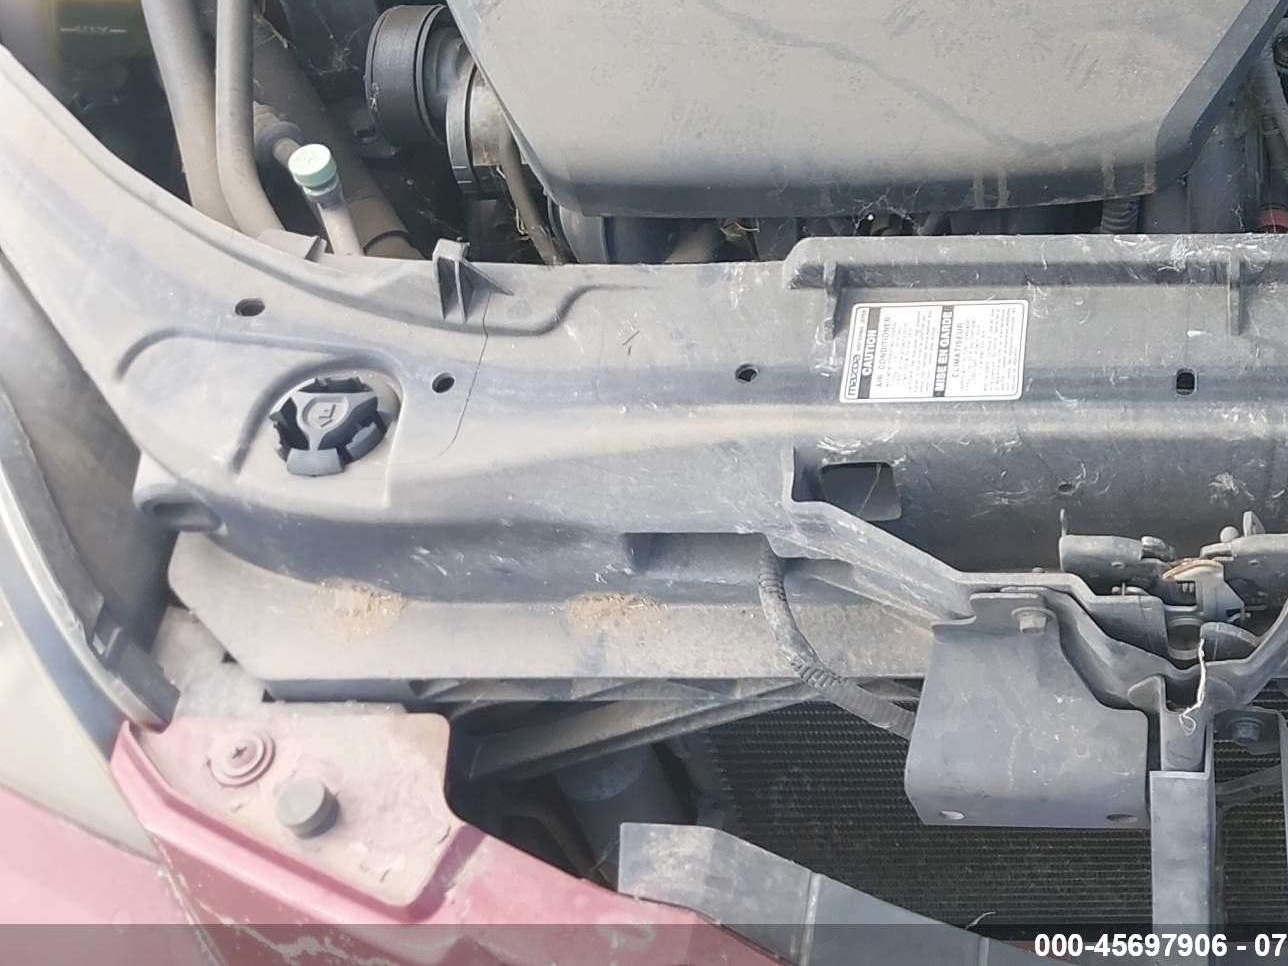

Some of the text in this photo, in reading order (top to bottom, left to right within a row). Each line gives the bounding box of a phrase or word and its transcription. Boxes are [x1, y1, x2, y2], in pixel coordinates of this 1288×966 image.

[862, 329, 877, 376] CAUTION
[877, 316, 891, 370] CONDITIONER
[934, 311, 953, 392] MISE EN GARDE
[951, 323, 964, 378] CLIMATISEUR
[847, 354, 862, 396] mazda
